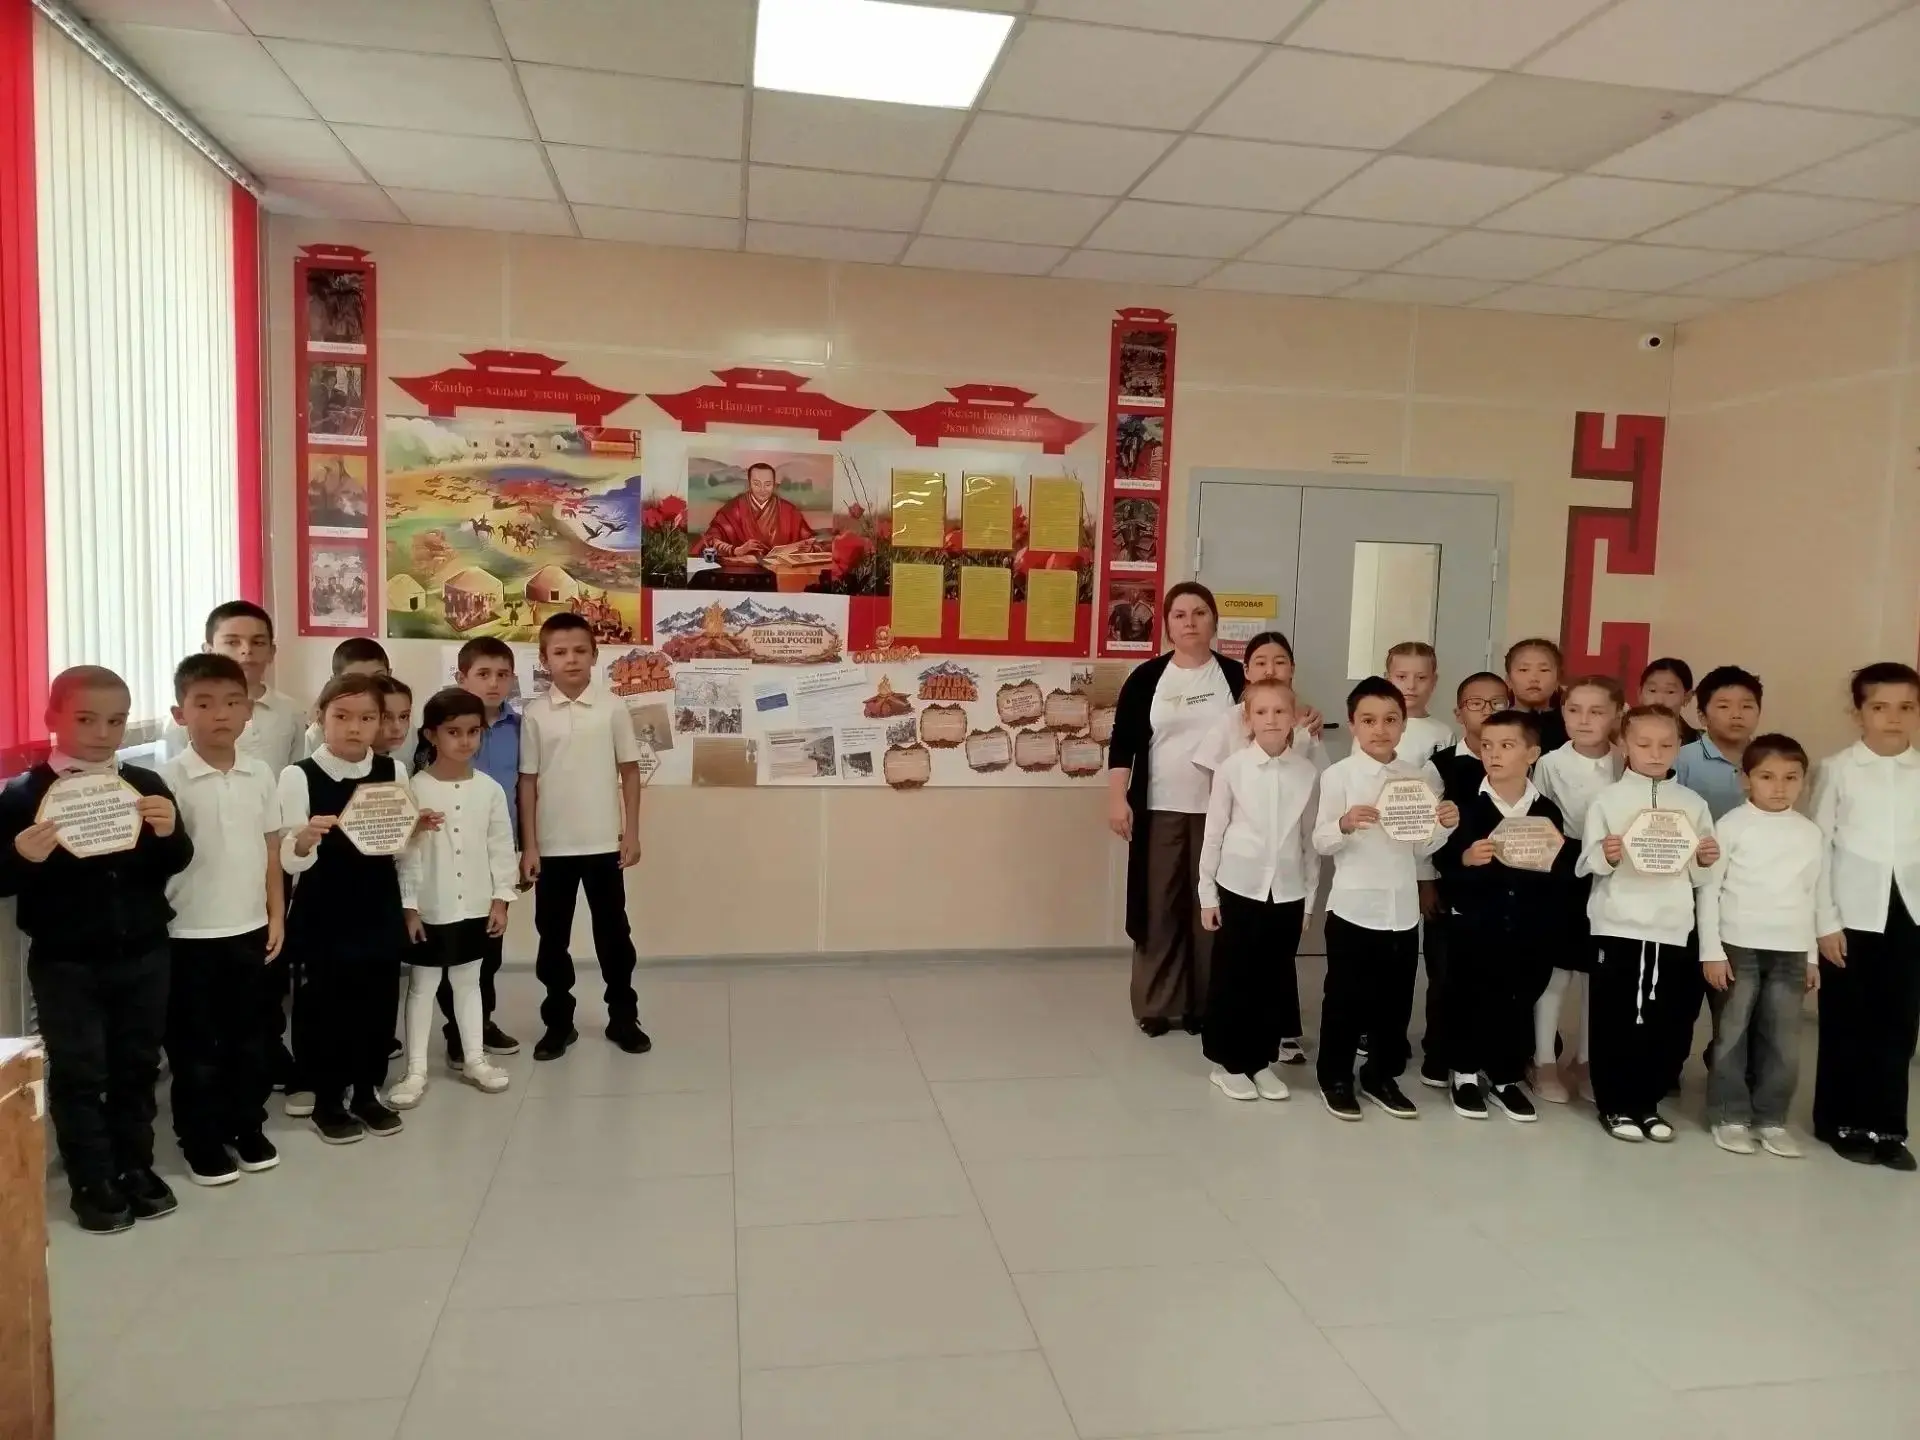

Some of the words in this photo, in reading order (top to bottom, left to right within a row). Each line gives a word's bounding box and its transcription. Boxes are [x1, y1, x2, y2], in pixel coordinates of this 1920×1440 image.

[876, 624, 894, 648] 9
[612, 656, 670, 684] 442
[927, 675, 970, 686] БИТВА
